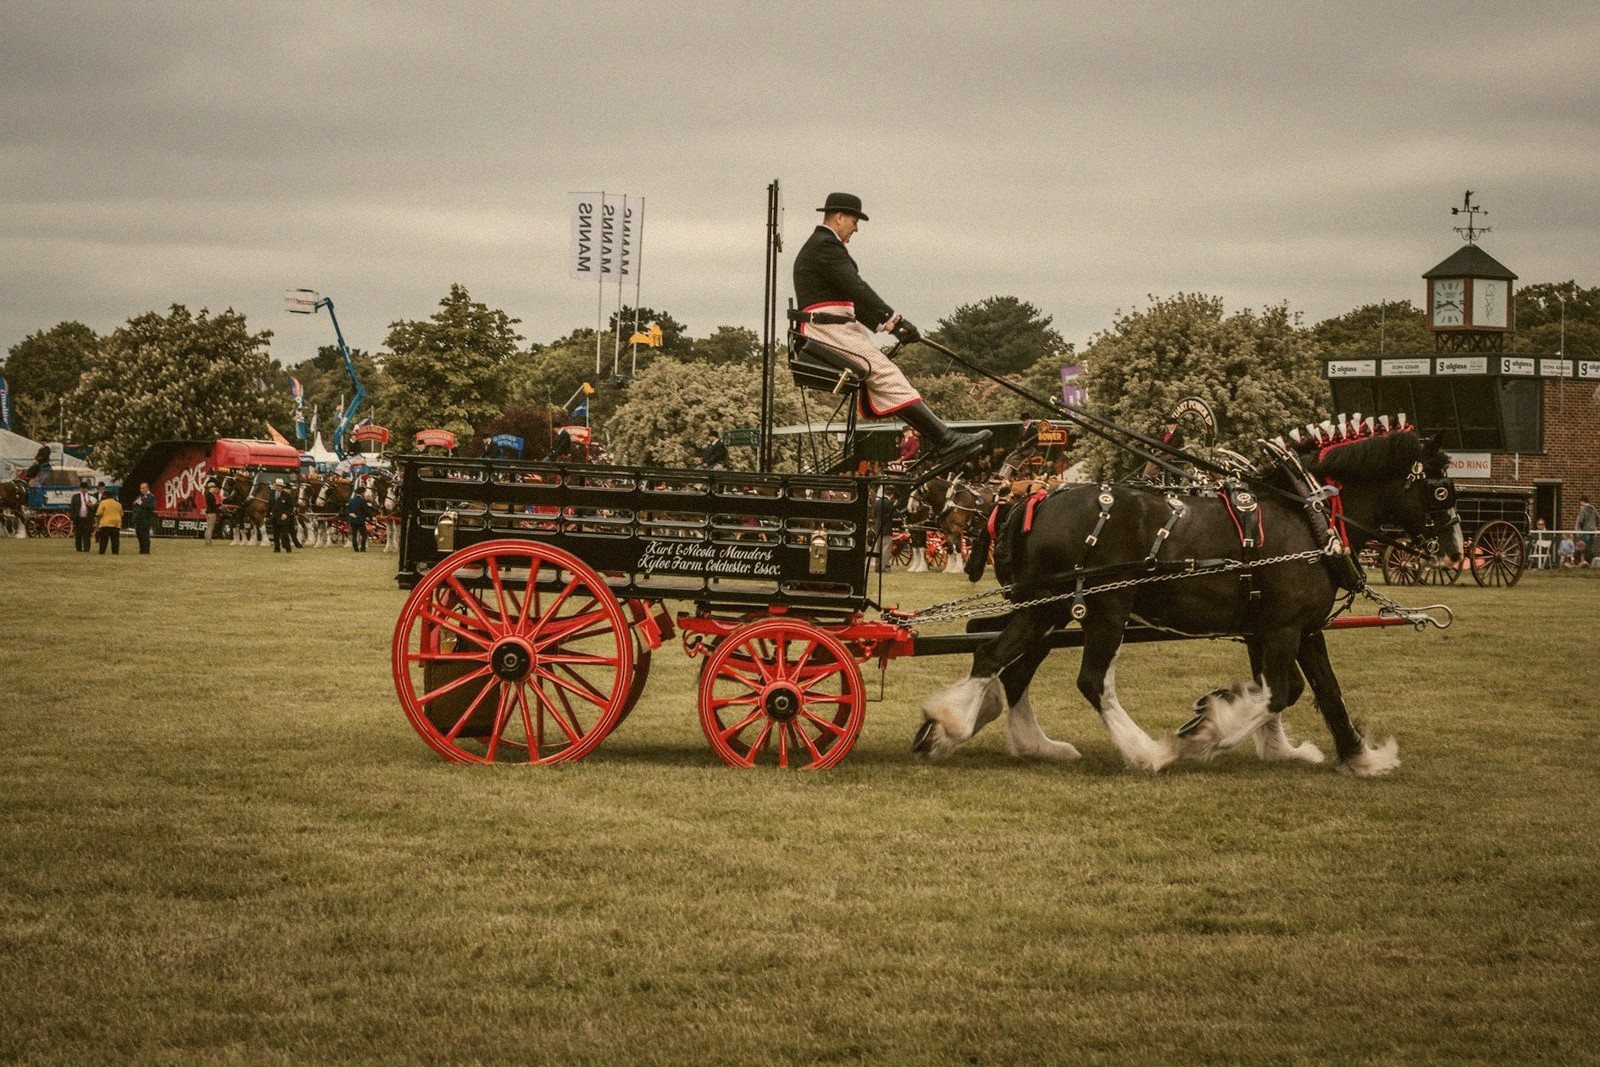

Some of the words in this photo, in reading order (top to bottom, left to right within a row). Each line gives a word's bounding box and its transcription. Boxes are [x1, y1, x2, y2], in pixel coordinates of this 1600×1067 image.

[1450, 461, 1464, 469] ND
[1466, 460, 1489, 469] RING
[645, 540, 675, 555] Kurt
[683, 543, 716, 557] Nicola
[719, 545, 774, 560] Manders
